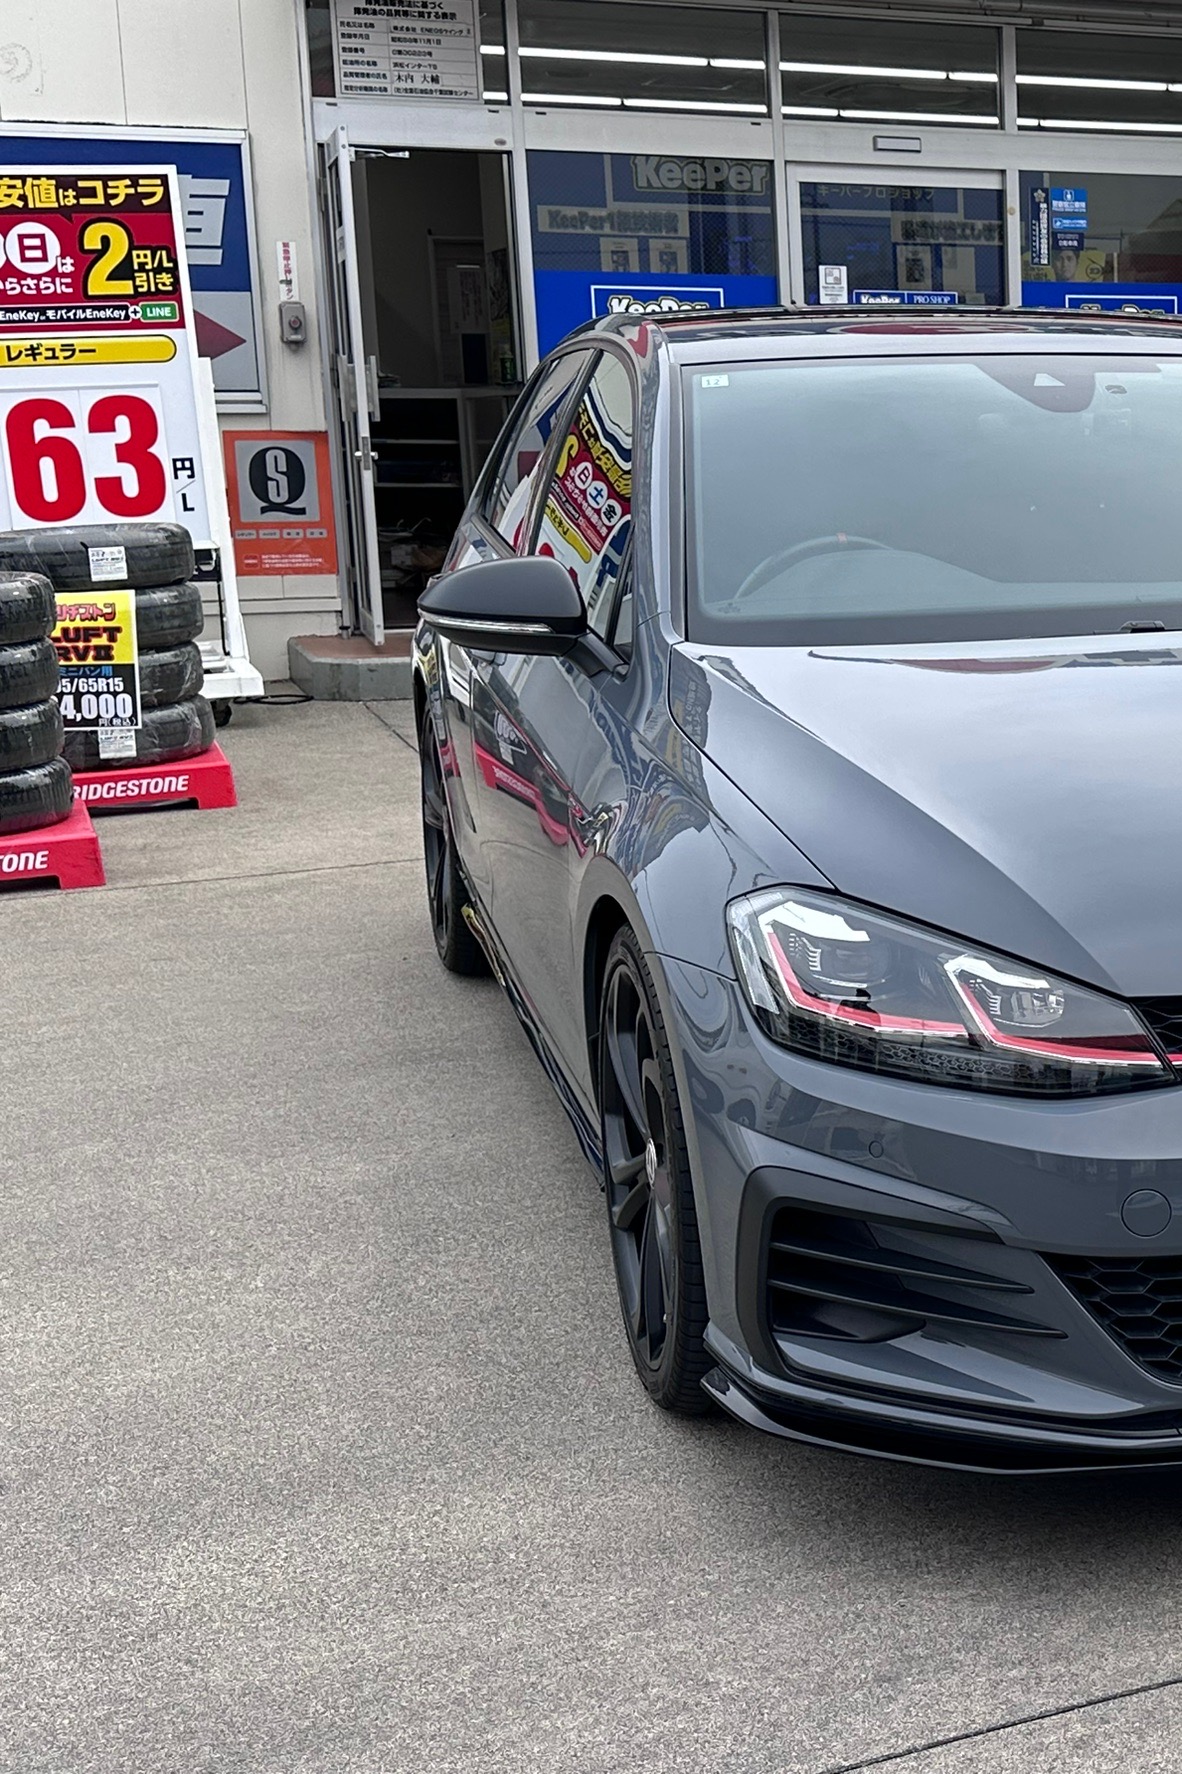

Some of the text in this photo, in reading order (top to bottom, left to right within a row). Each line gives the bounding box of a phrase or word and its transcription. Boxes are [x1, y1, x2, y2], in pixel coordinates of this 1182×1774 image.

[633, 156, 769, 194] KeePer
[0, 177, 165, 209] 安値はコチラ
[83, 221, 135, 296] 2
[134, 272, 174, 293] 引き
[146, 307, 172, 317] LINE
[6, 343, 97, 362] レギュラー
[60, 666, 113, 677] ミニバン用
[53, 693, 133, 721] 4,000
[73, 775, 190, 800] RIDGESTONE
